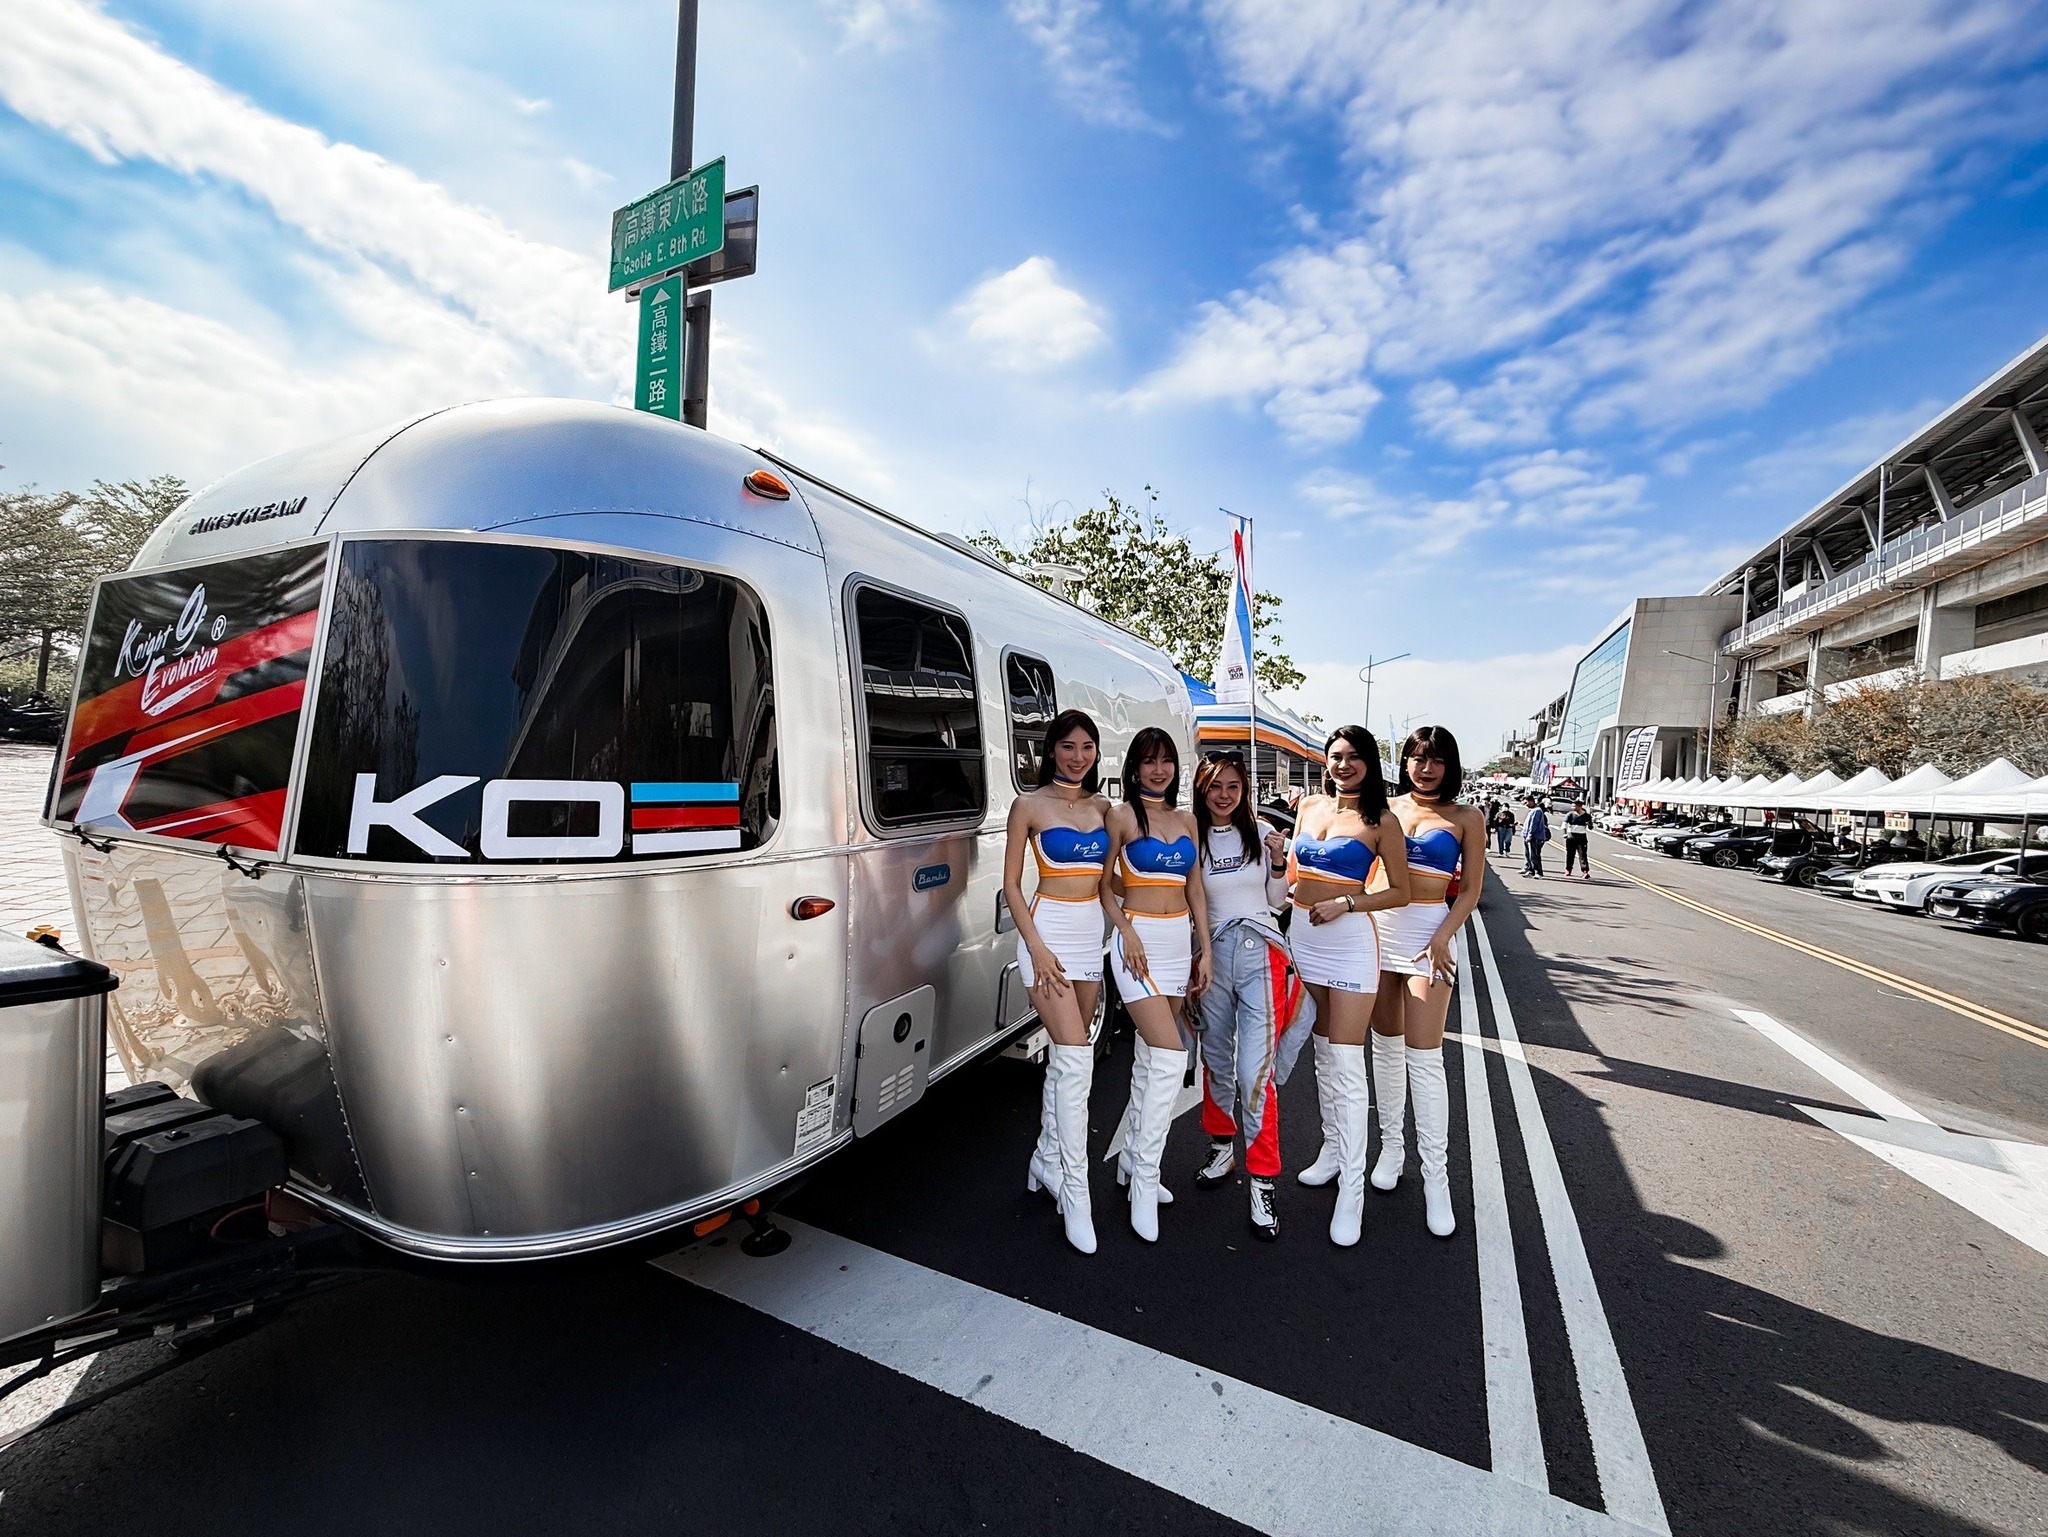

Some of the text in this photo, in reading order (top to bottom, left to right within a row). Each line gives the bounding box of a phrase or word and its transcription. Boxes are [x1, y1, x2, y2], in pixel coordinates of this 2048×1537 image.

[624, 176, 709, 249] 高鐵東八路
[623, 226, 708, 276] Gaotie E. 8th Rd.
[188, 496, 308, 535] AIRSTREAM
[114, 618, 174, 678] Knight
[141, 648, 218, 711] Evolution
[918, 870, 948, 885] Bambi
